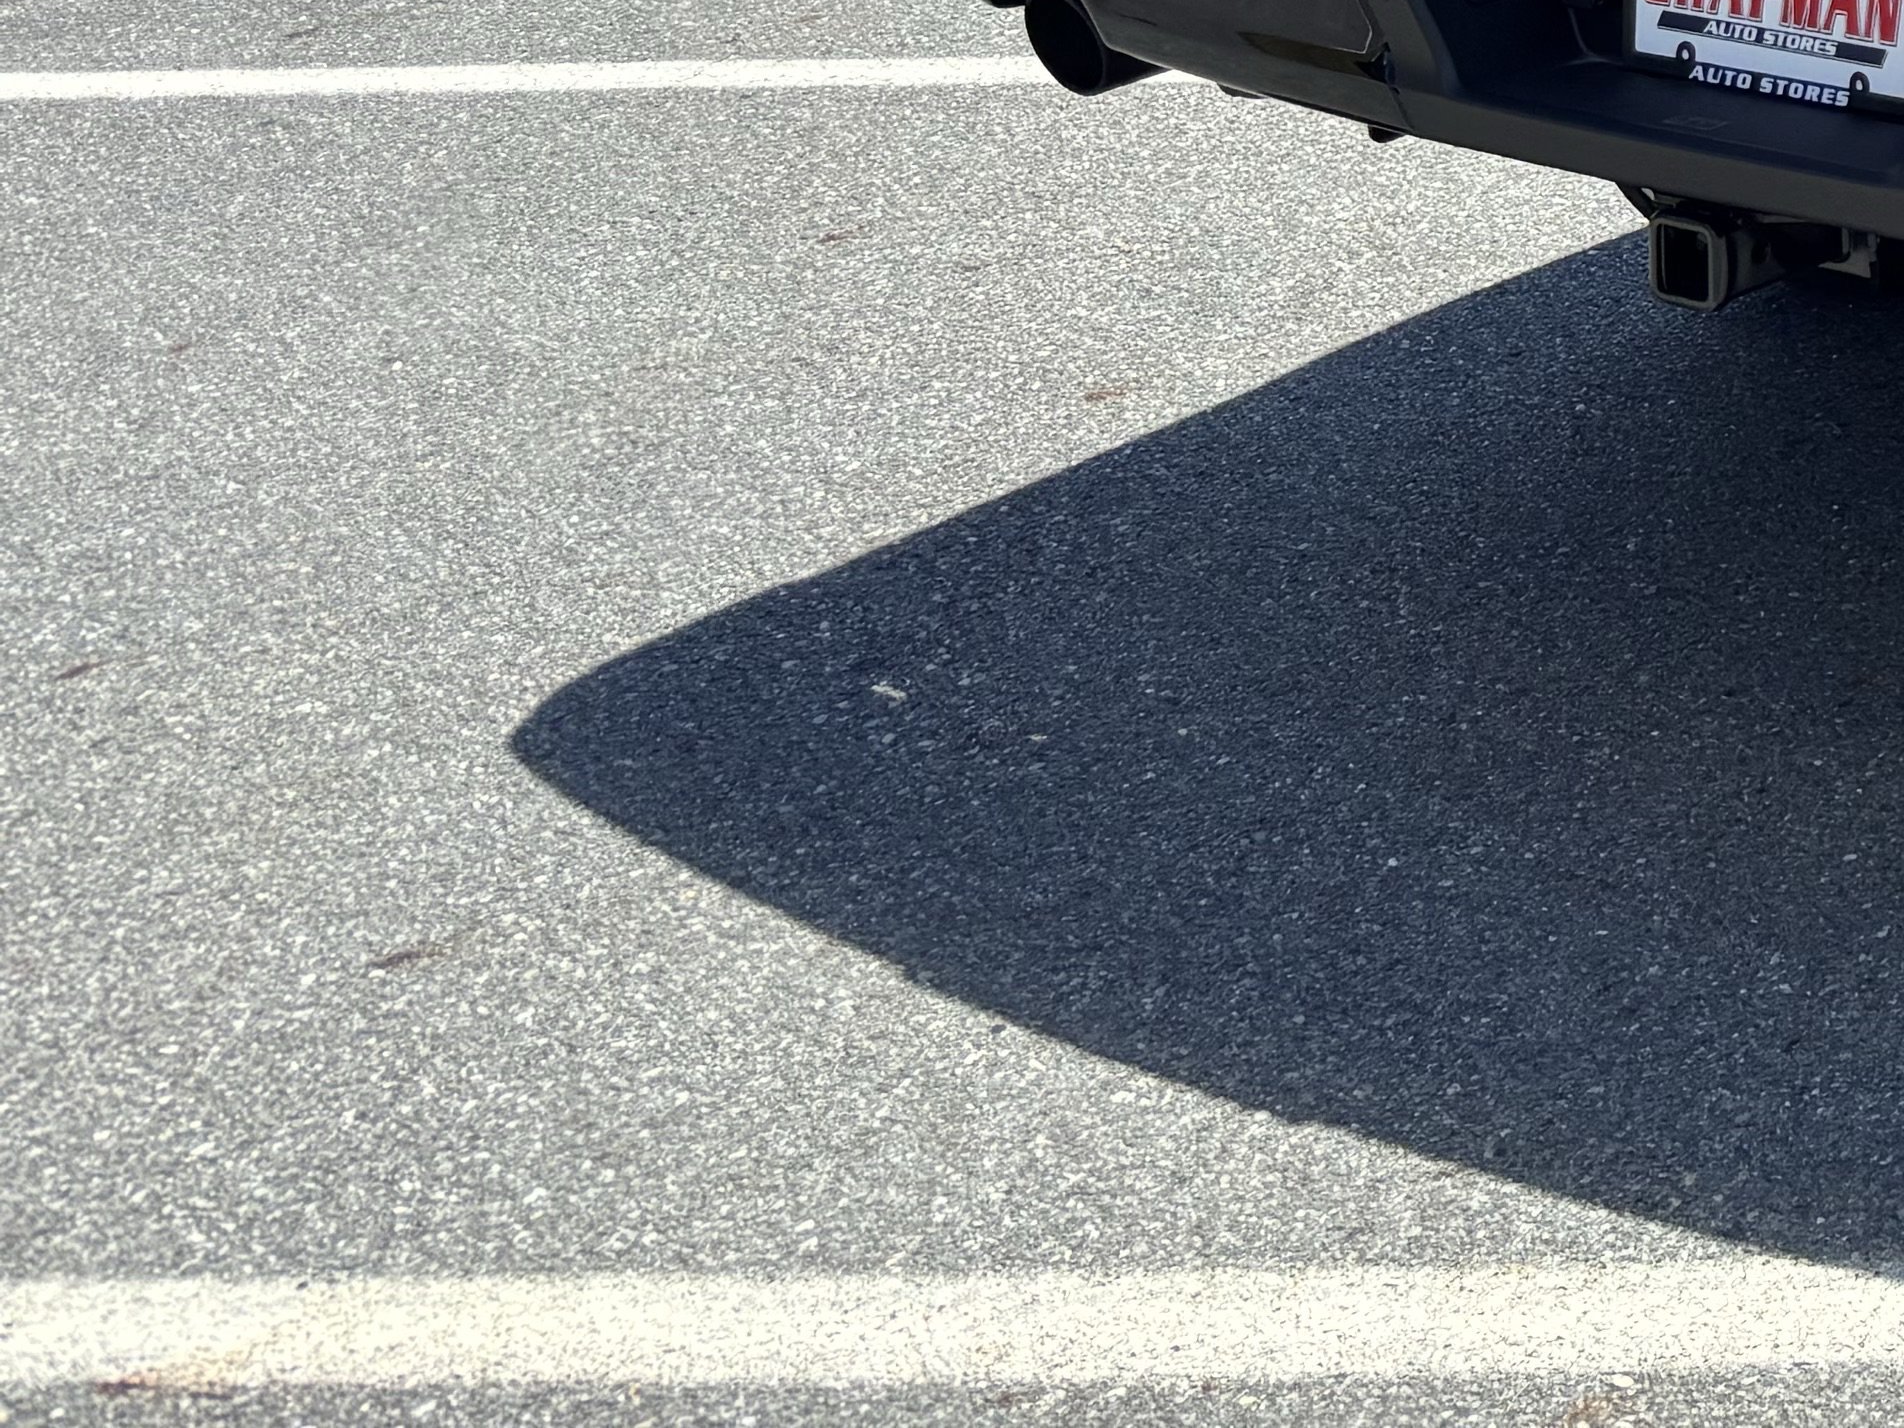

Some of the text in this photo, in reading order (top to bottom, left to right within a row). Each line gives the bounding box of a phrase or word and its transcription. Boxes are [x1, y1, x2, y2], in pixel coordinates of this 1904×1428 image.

[1703, 20, 1840, 57] AUTO STORES
[1688, 64, 1850, 108] AUTO STORES
